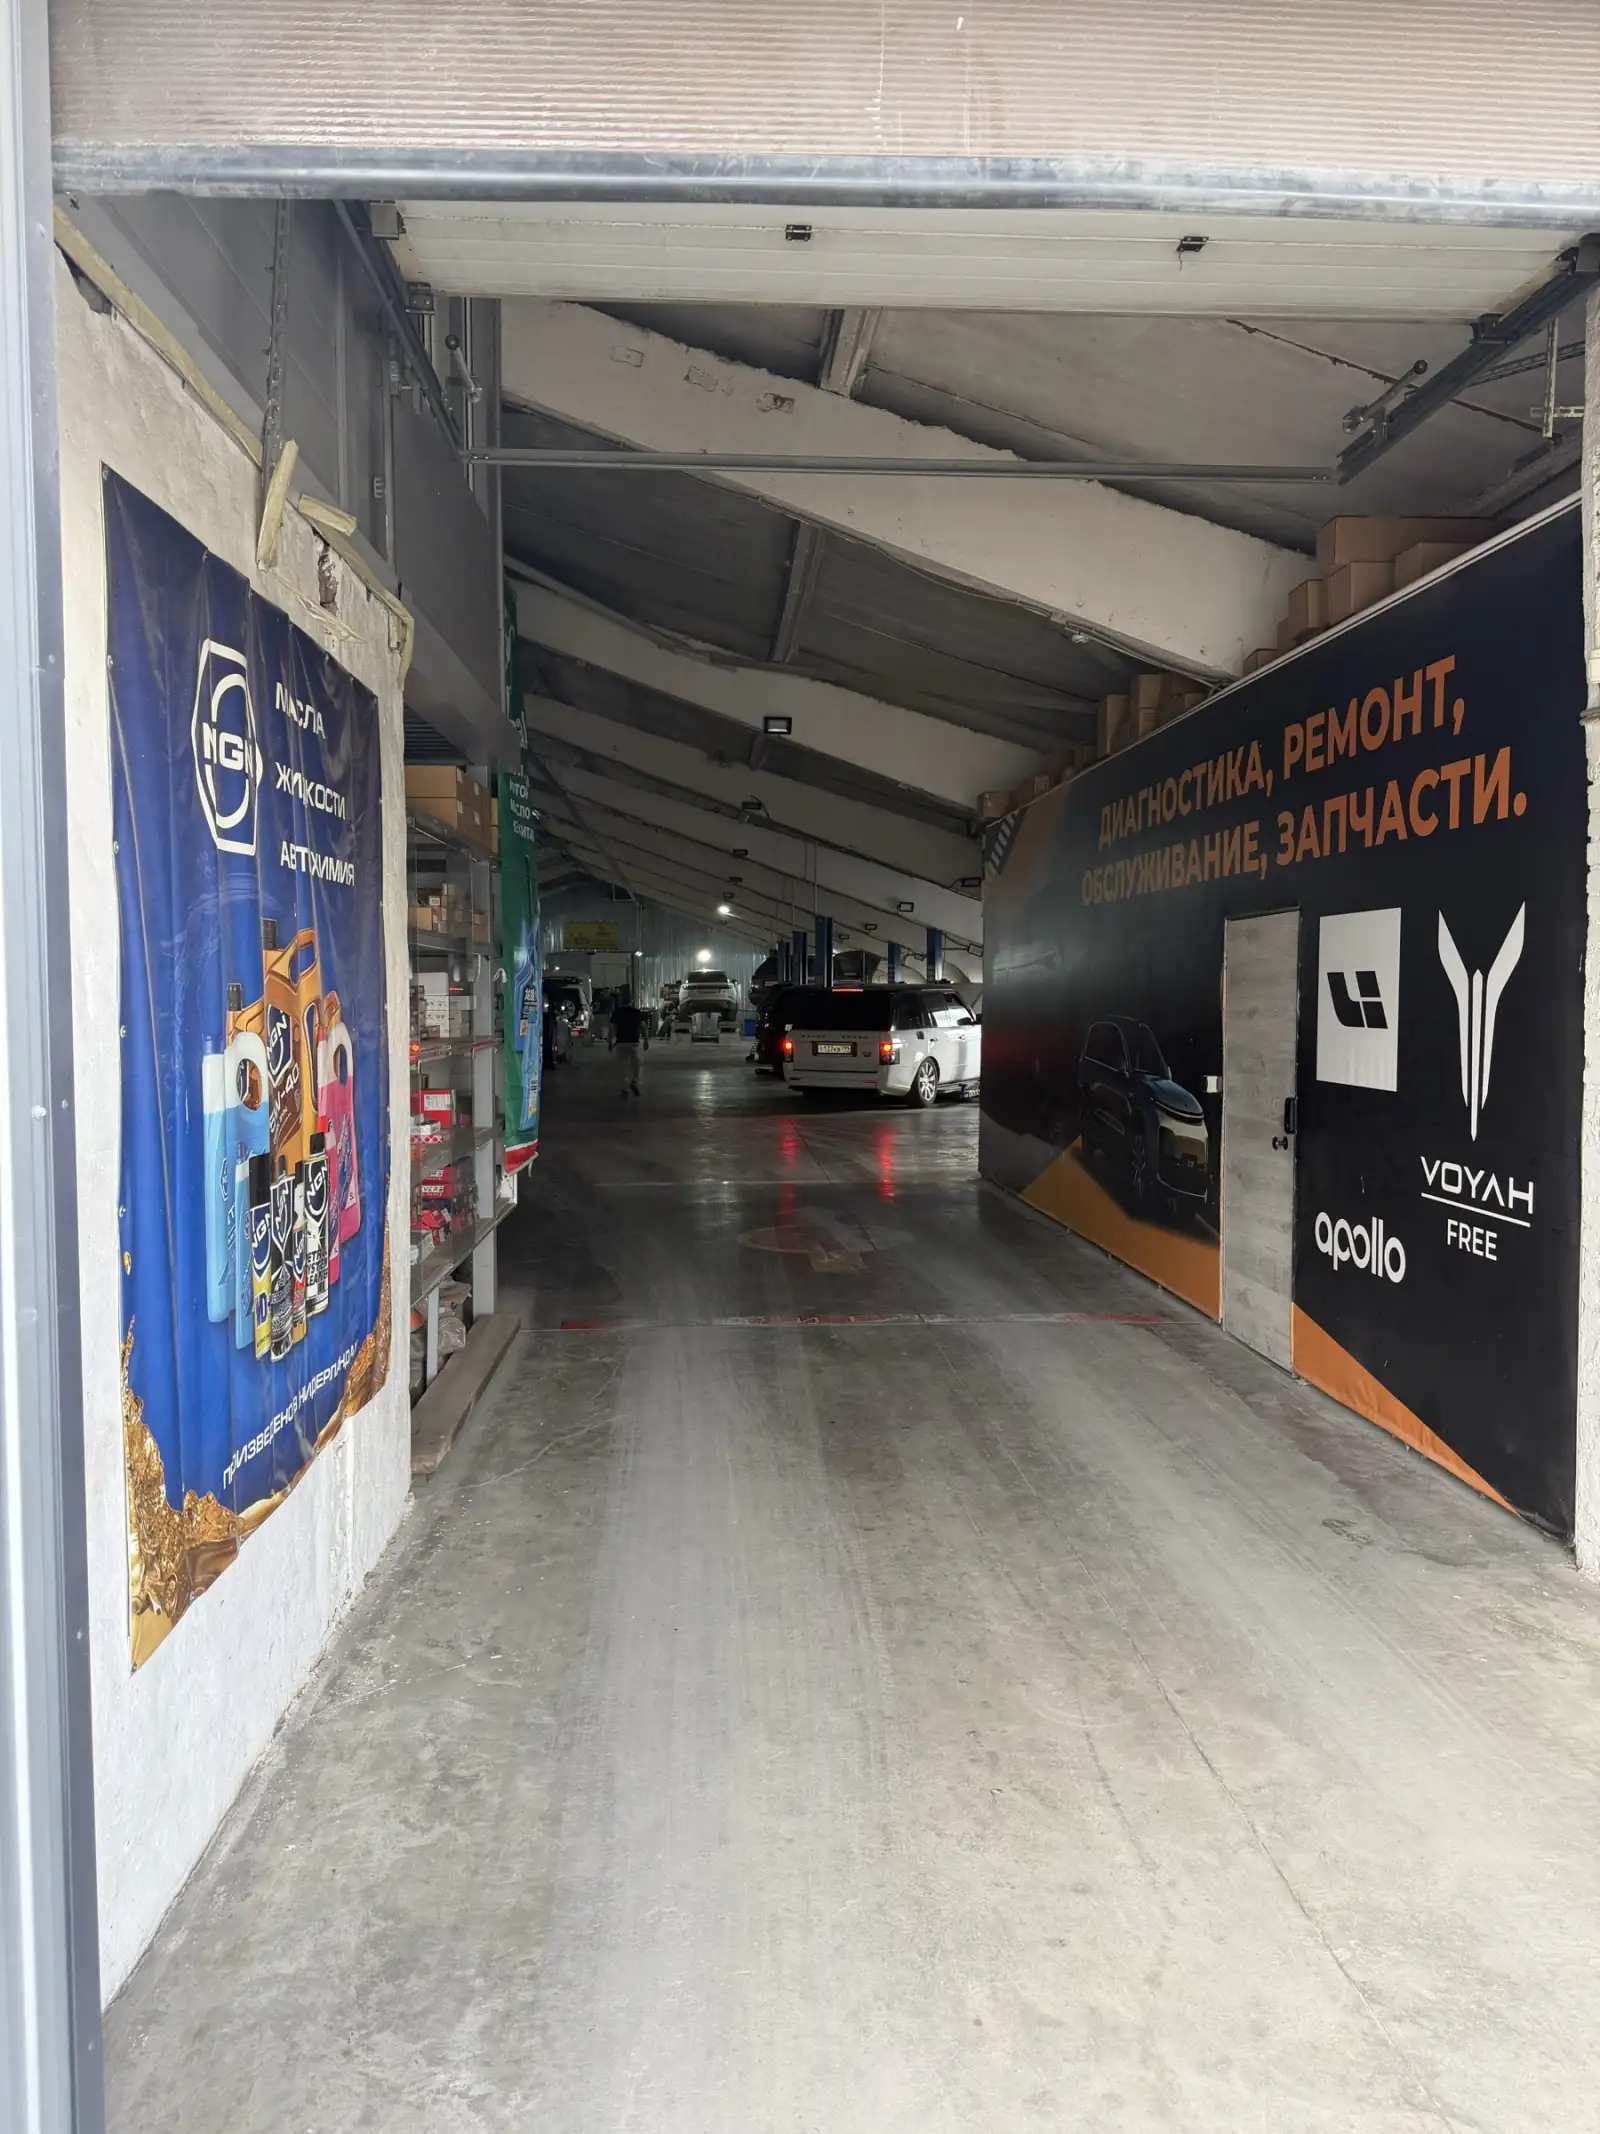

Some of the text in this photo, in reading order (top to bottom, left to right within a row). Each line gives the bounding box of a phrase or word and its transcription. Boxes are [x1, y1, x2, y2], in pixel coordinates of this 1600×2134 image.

[275, 682, 327, 740] МАСЛА
[1098, 655, 1465, 853] ДИАГНОСТИКА, РЕМОНТ,
[1081, 746, 1528, 906] ОБСЛУЖИВАНИЕ, ЗАПЧАСТИ.
[280, 840, 355, 887] АВТХИМИЯ
[1420, 1156, 1534, 1214] VOYAH
[1314, 1211, 1406, 1284] apollo
[1447, 1219, 1497, 1261] FREE
